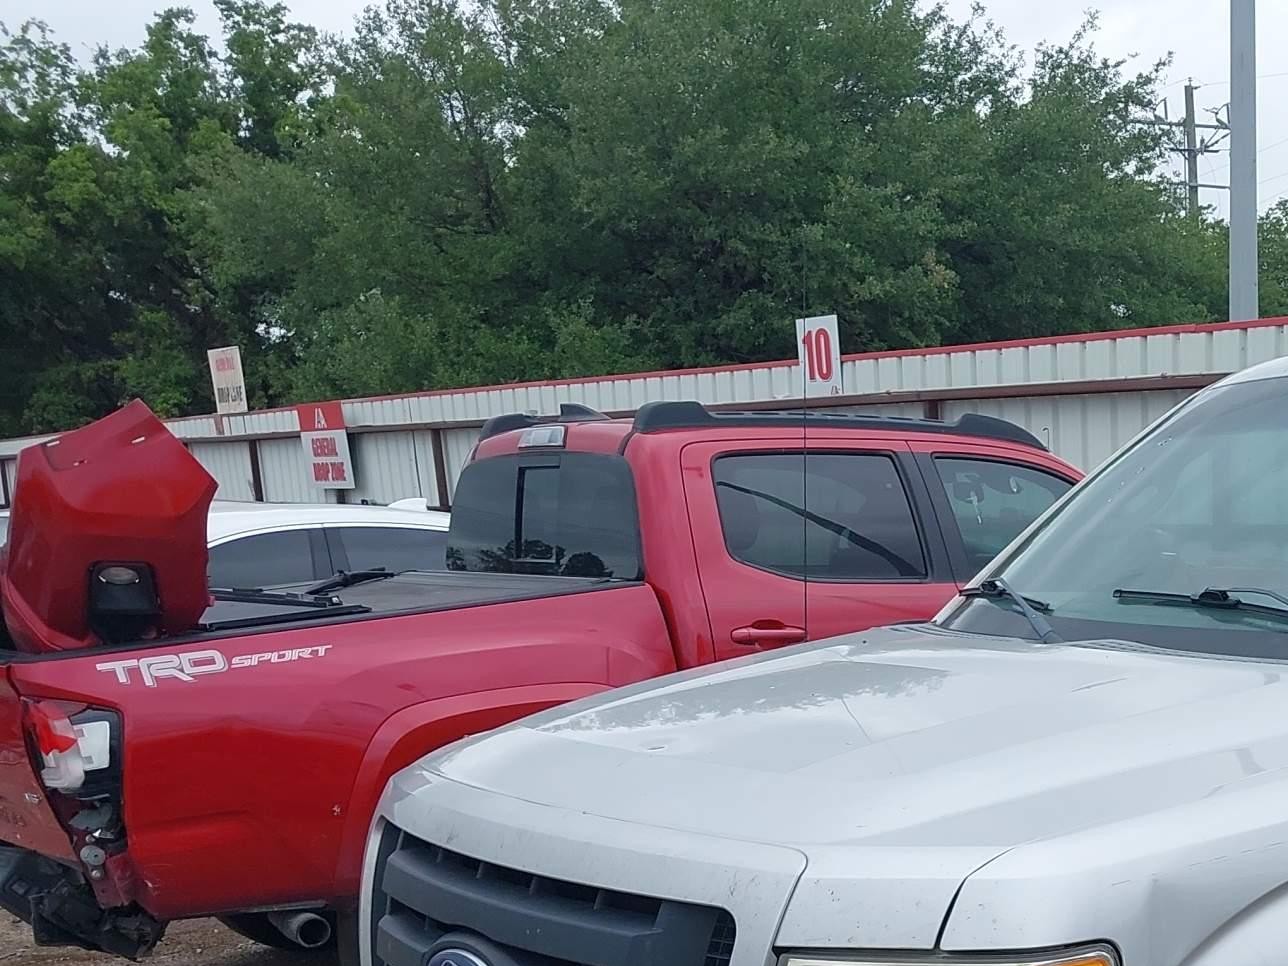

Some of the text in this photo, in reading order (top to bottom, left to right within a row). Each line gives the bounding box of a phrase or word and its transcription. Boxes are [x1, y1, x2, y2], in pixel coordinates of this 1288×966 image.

[802, 328, 832, 380] 10
[96, 645, 333, 688] TRD SPORT
